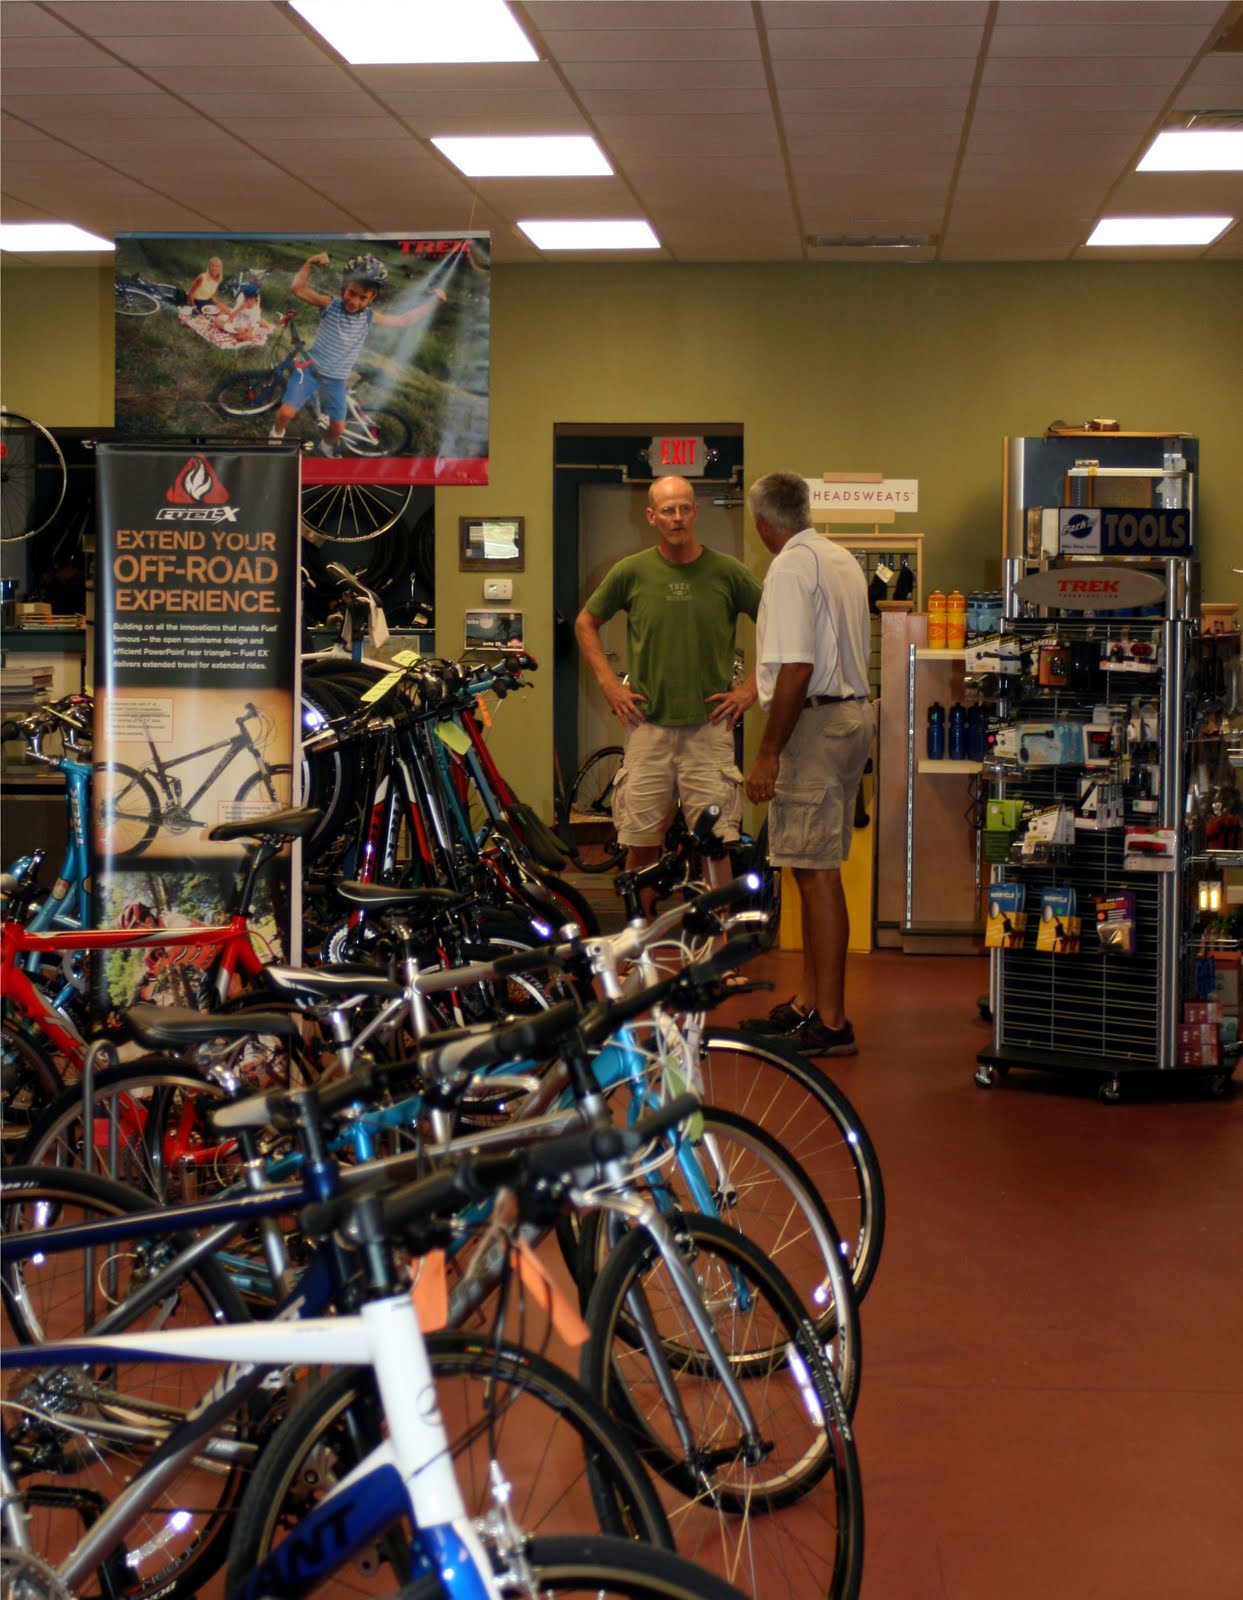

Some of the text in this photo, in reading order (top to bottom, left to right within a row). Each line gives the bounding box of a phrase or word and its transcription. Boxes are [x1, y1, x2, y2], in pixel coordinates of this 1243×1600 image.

[661, 438, 697, 465] EXIT
[813, 491, 910, 502] HEADSWEATS
[1104, 514, 1187, 548] TOOLS
[116, 530, 277, 551] EXTEND YOUR
[113, 554, 279, 584] OFF-ROAD
[1057, 580, 1120, 593] TREK
[115, 589, 281, 612] EXPERIENCE.
[113, 622, 143, 631] Building
[180, 623, 221, 631] innovations
[238, 624, 259, 632] made
[183, 636, 222, 644] mainframe
[223, 637, 248, 645] design
[143, 648, 185, 656] PowerPoint
[203, 649, 231, 657] triangle
[240, 649, 256, 657] Fuel
[112, 660, 141, 668] delivers
[199, 661, 210, 669] for
